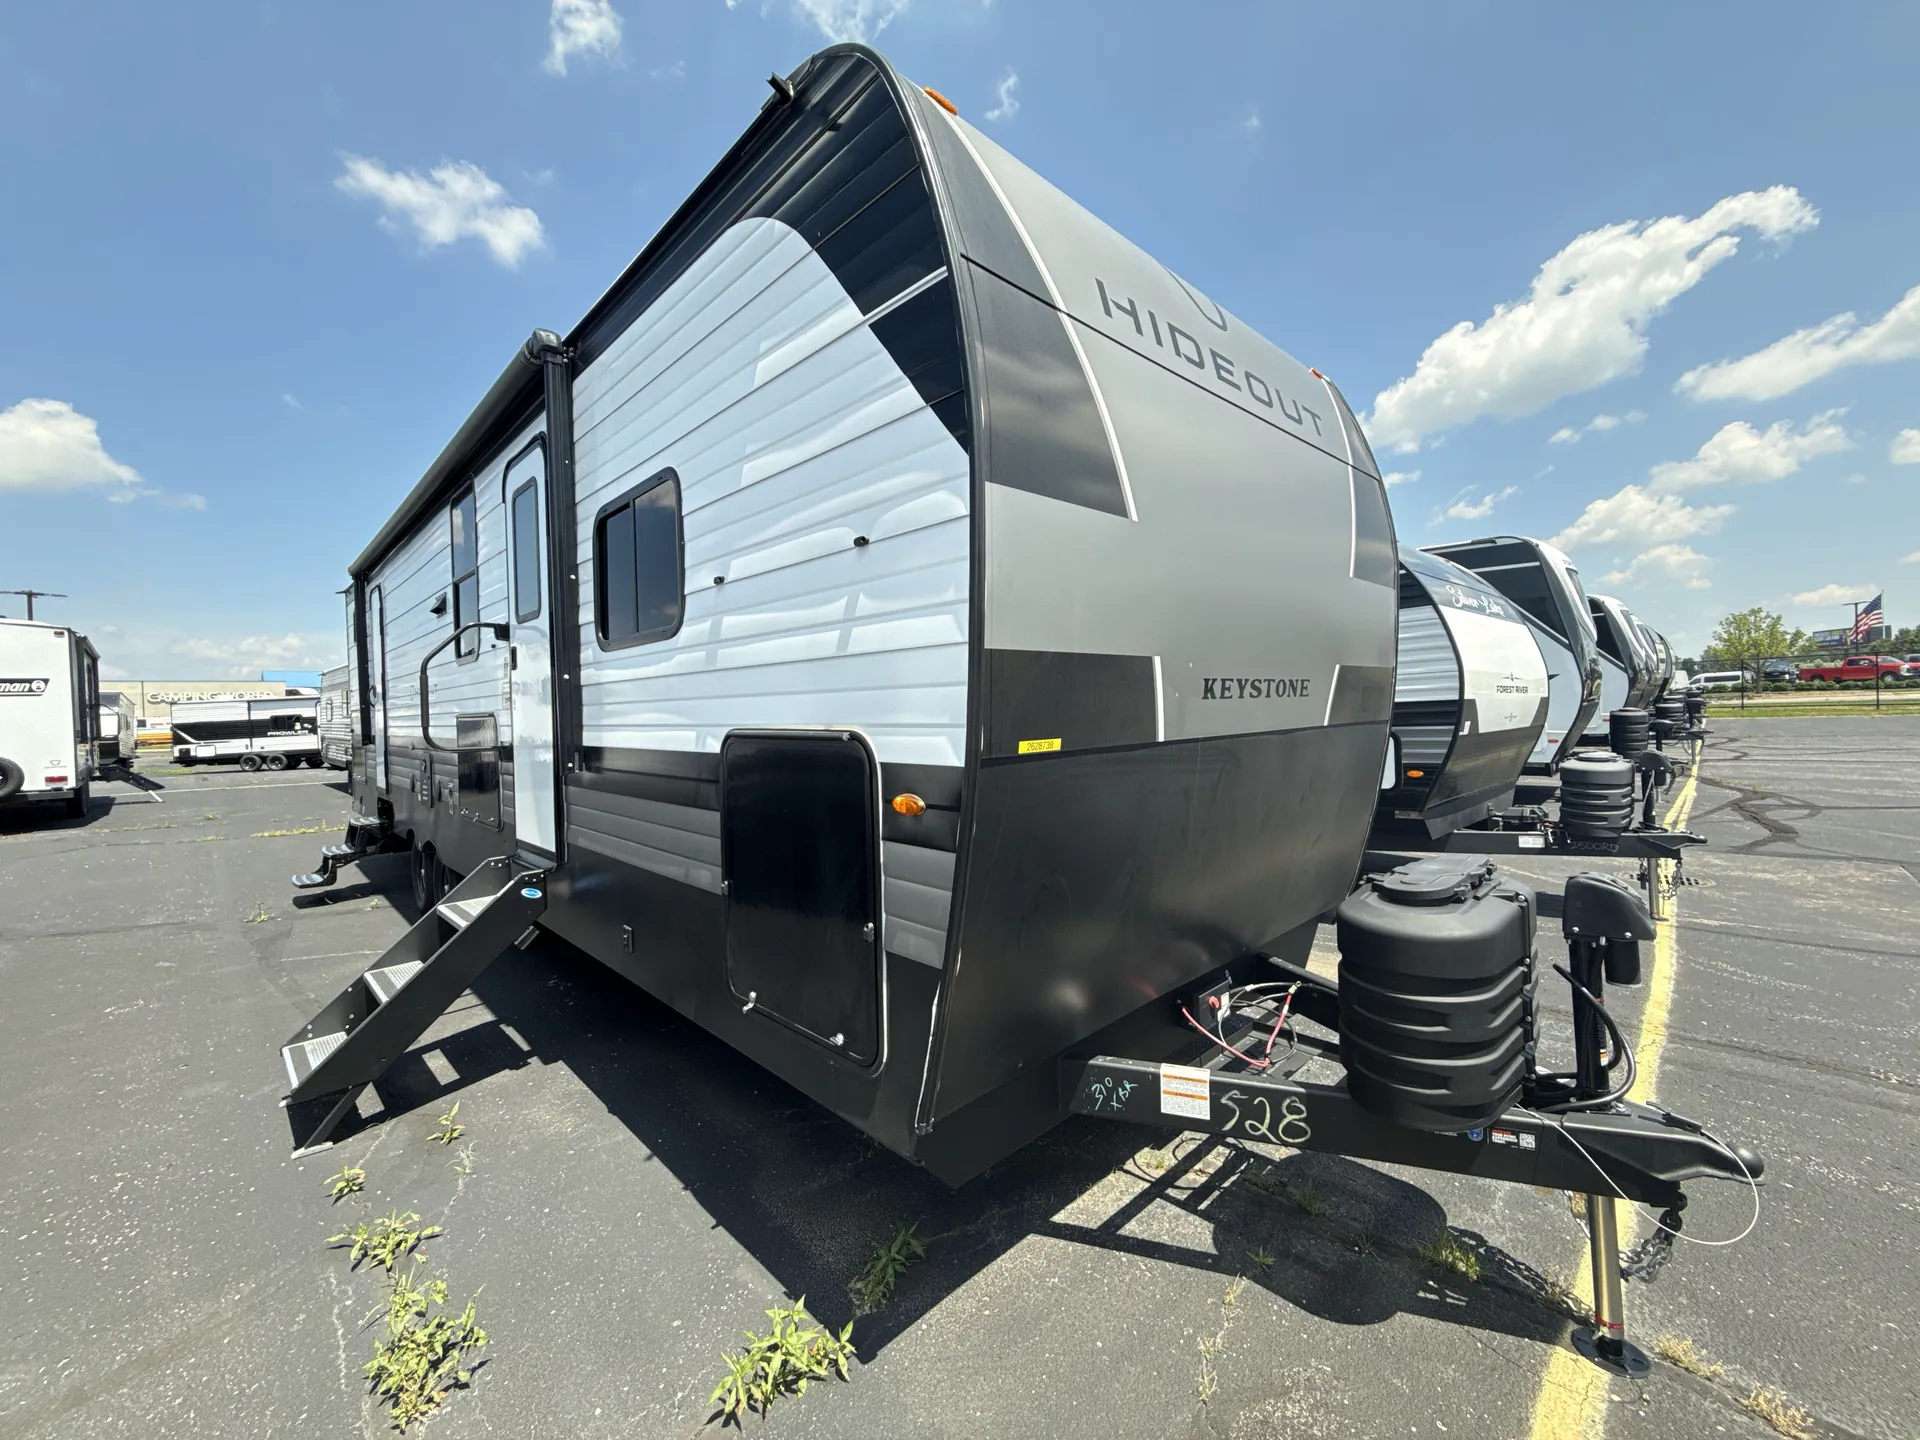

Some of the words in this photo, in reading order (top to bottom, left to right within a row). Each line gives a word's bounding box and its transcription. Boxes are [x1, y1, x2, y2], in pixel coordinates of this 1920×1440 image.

[1095, 277, 1322, 436] HIDEOUT
[147, 691, 217, 703] CAMPING
[1202, 678, 1310, 700] KEYSTONE
[1497, 685, 1515, 694] FOREST
[1515, 685, 1529, 694] RIVER
[1027, 741, 1054, 751] 2628738
[1220, 1090, 1311, 1144] 528
